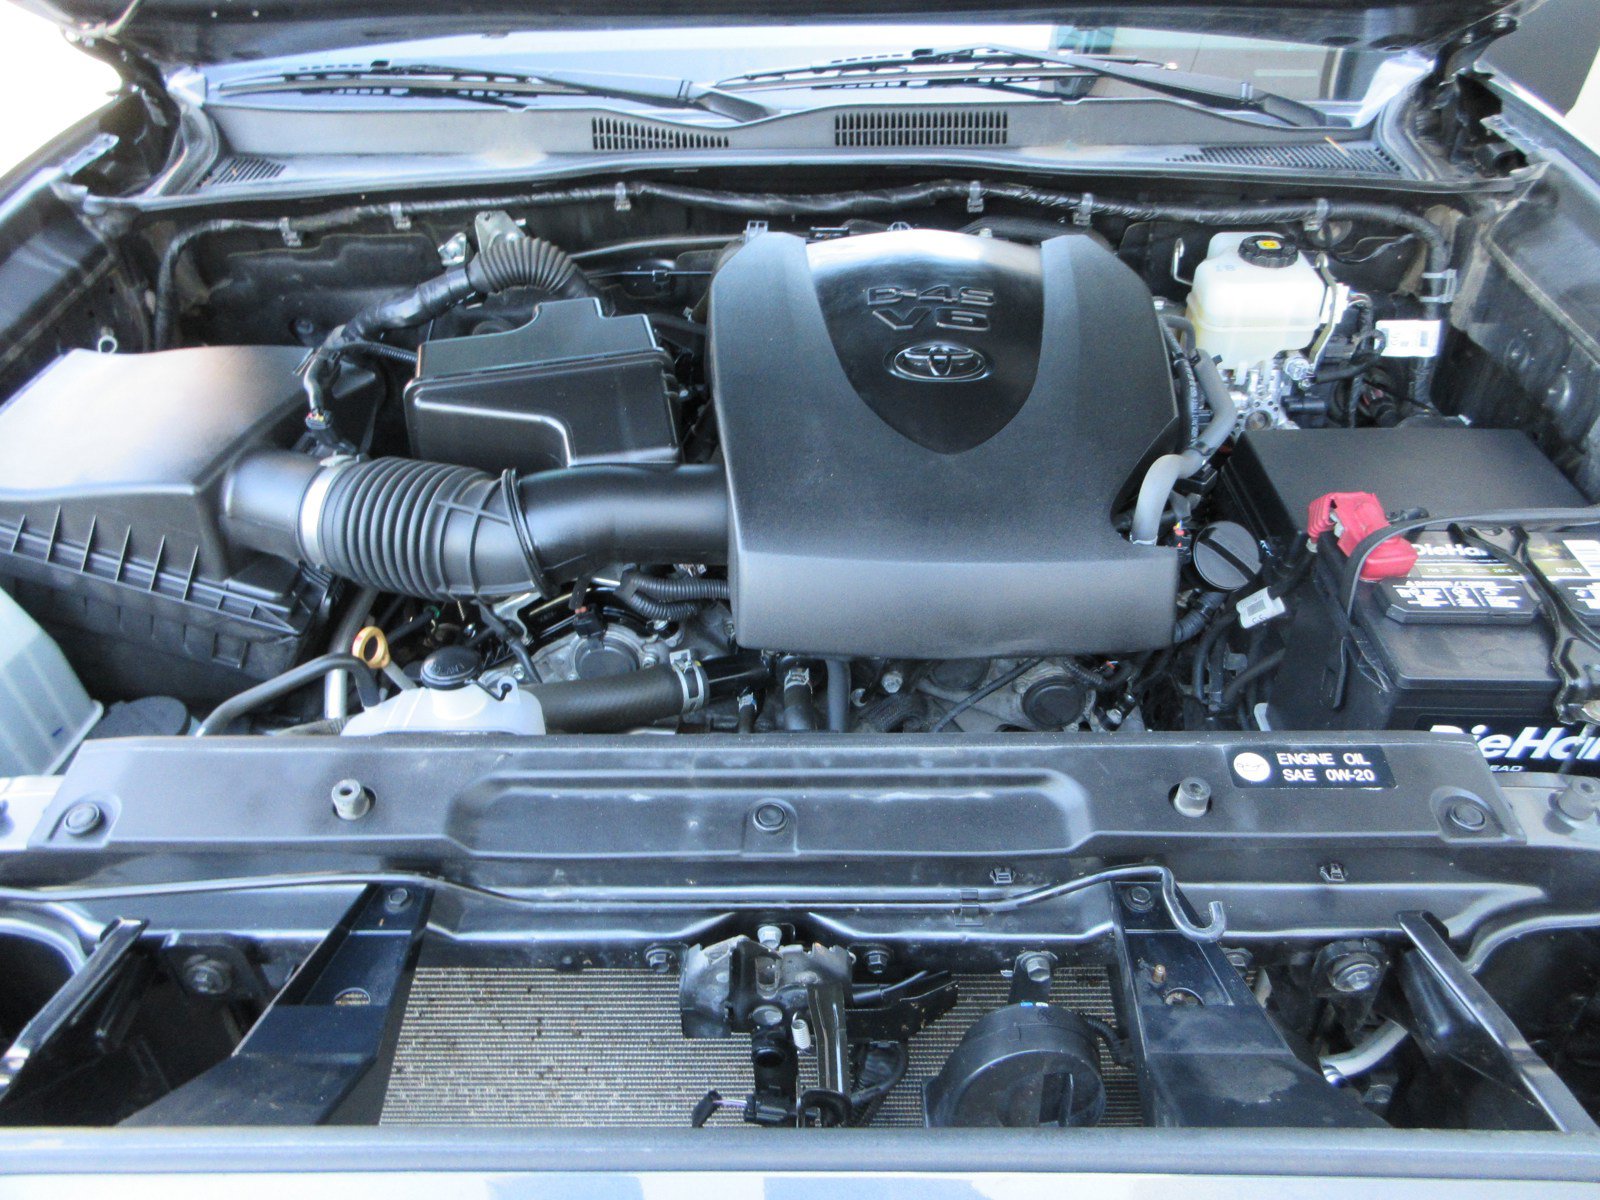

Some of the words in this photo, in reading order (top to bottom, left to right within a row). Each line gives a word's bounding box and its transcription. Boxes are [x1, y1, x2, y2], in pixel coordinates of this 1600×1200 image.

[867, 284, 995, 306] D-4S
[872, 306, 990, 331] V6
[1276, 752, 1335, 765] ENGINE
[1342, 753, 1371, 765] OIL
[1282, 768, 1316, 781] SAE
[1325, 769, 1375, 782] 0W-20
[1488, 764, 1523, 772] EAD
